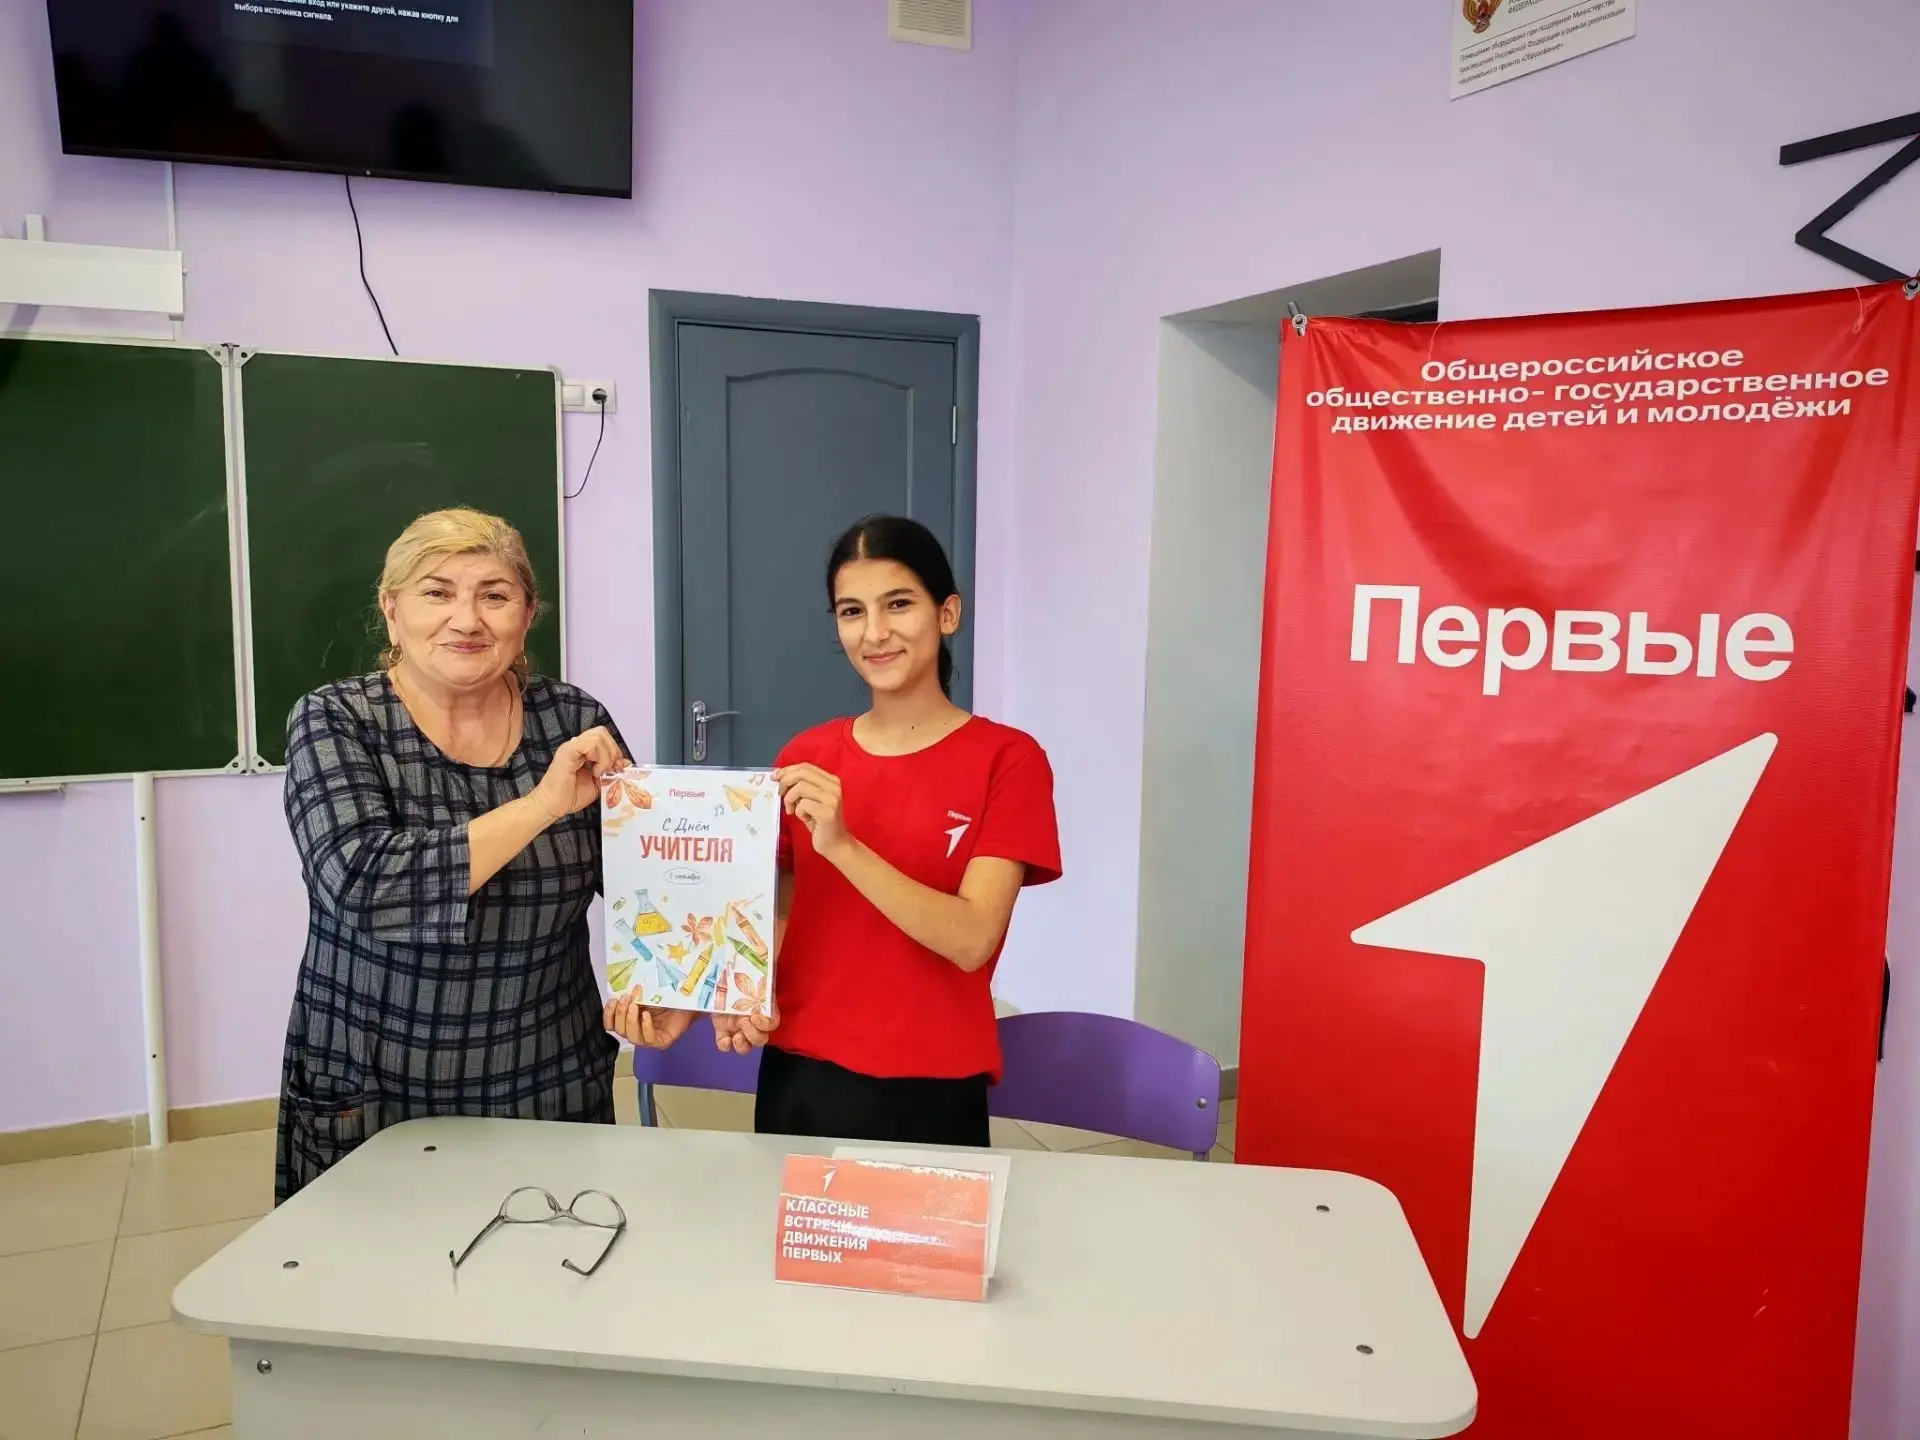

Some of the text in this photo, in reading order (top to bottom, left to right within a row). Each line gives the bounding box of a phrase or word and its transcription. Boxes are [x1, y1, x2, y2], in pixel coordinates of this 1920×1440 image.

[234, 3, 334, 21] выбора источника сигнала.
[326, 1, 340, 9] или
[340, 2, 370, 11] укажите
[371, 6, 397, 16] другой,
[398, 9, 420, 18] нажав
[421, 12, 445, 22] кнопку
[1526, 28, 1539, 38] при
[1565, 21, 1587, 36] рамках
[1420, 348, 1744, 383] Общероссийское
[1305, 367, 1890, 410] общественно- государственное
[1331, 395, 1852, 434] движение детей и молодёжи
[1349, 583, 1795, 697] Первые
[669, 788, 706, 800] Первые
[662, 817, 710, 834] С Днём
[639, 835, 733, 863] УЧИТЕЛЯ
[786, 1199, 870, 1219] КЛАССНЫЕ
[782, 1231, 868, 1251] ДВИЖЕНИЯ
[782, 1245, 844, 1264] ПЕРВЫХ
